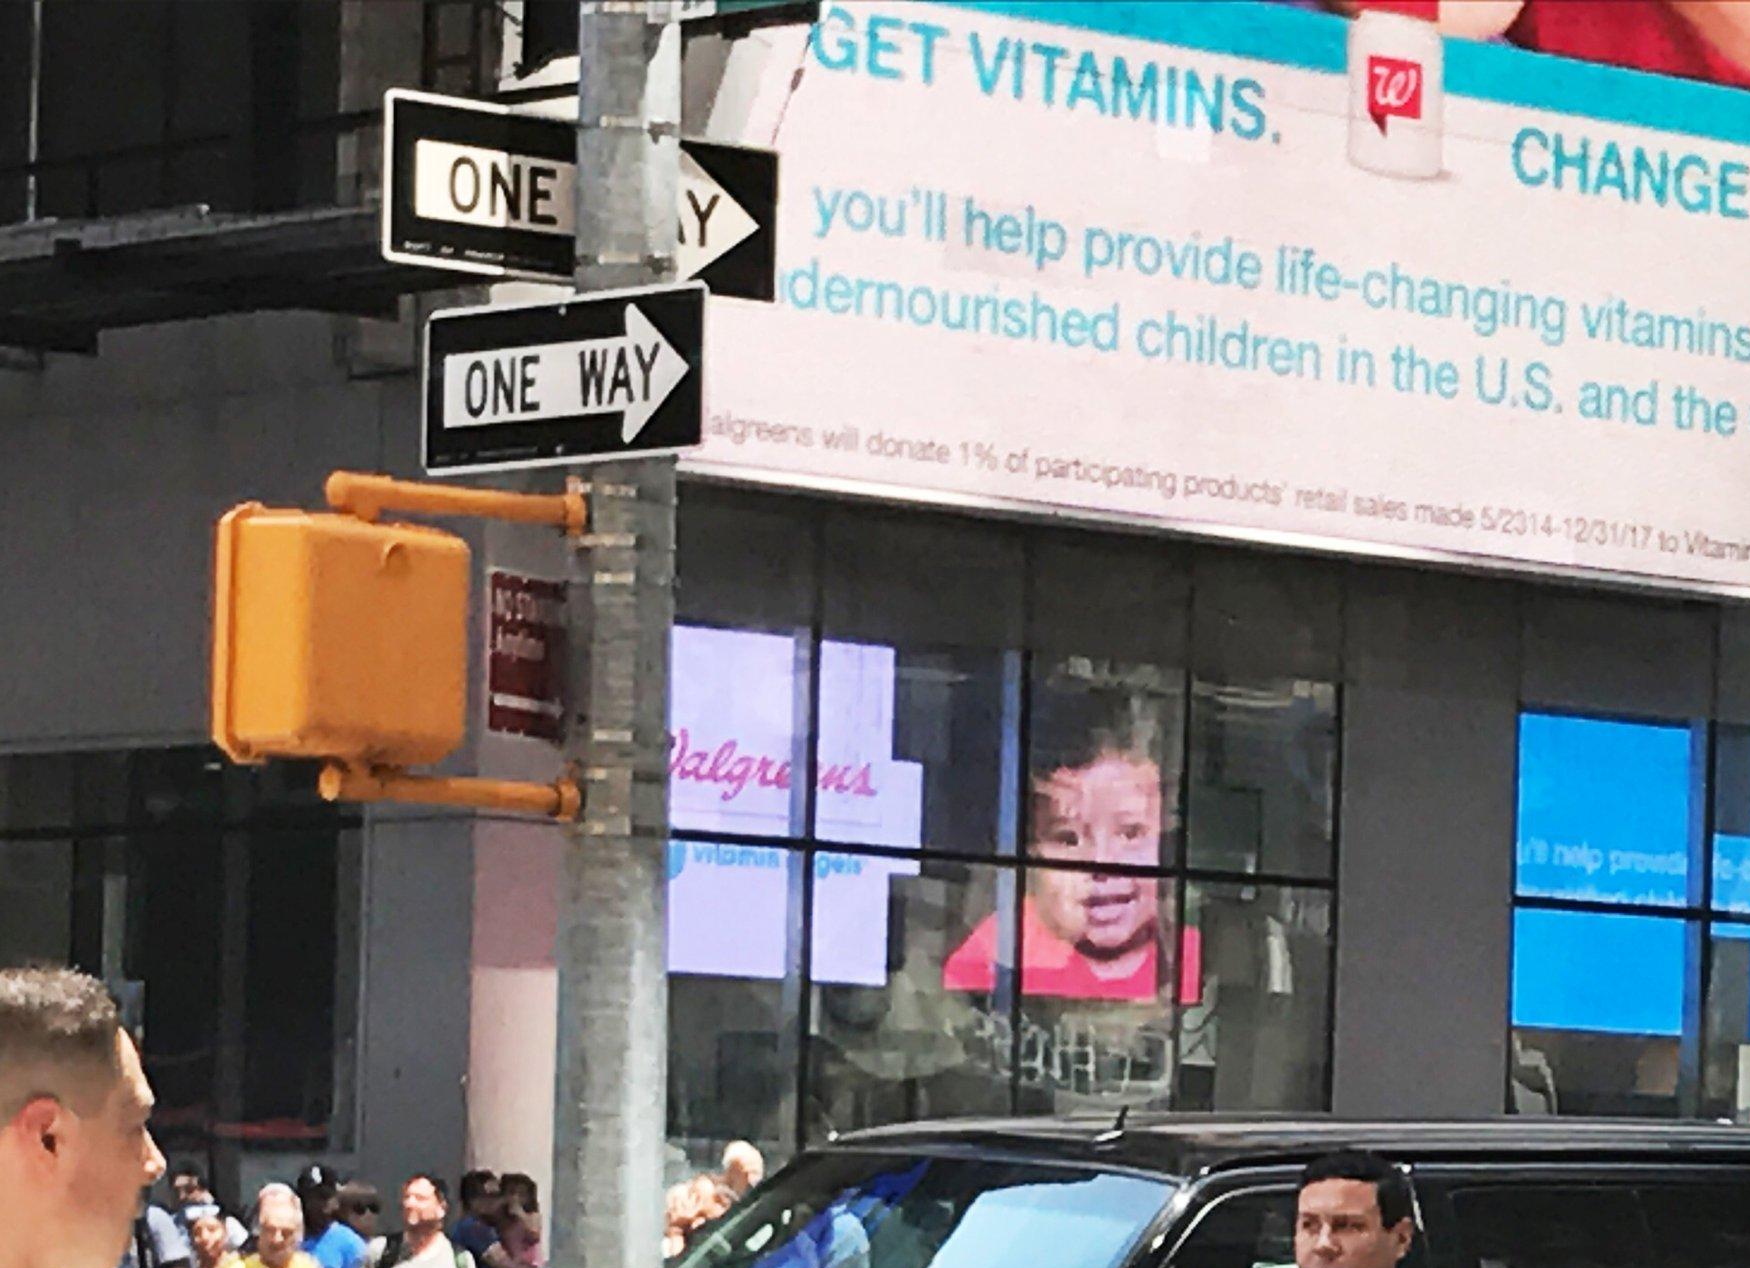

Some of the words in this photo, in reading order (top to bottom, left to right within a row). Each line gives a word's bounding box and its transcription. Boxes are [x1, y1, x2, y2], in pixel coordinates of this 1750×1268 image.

[810, 7, 949, 86] GET
[968, 31, 1282, 144] VITAMINS.
[449, 156, 558, 226] ONE
[1511, 127, 1750, 219] CHANGE
[812, 185, 948, 241] you'll
[964, 197, 1067, 271] help
[1084, 226, 1263, 289] provide
[1277, 243, 1566, 347] life-changing
[464, 353, 541, 417] ONE
[578, 342, 661, 407] WAY
[780, 256, 1119, 352] dernourished
[1136, 309, 1321, 378] children
[1336, 333, 1377, 388] in
[1390, 348, 1459, 399] the
[1475, 355, 1563, 416] U.S.
[1577, 376, 1657, 427] and
[1673, 387, 1738, 438] the
[706, 408, 813, 447] algreens
[821, 426, 860, 452] will
[865, 431, 950, 464] donate
[1004, 448, 1029, 474] of
[1034, 456, 1178, 499] participating
[1353, 494, 1408, 522] sales
[1414, 502, 1475, 529] made
[1658, 530, 1678, 554] to
